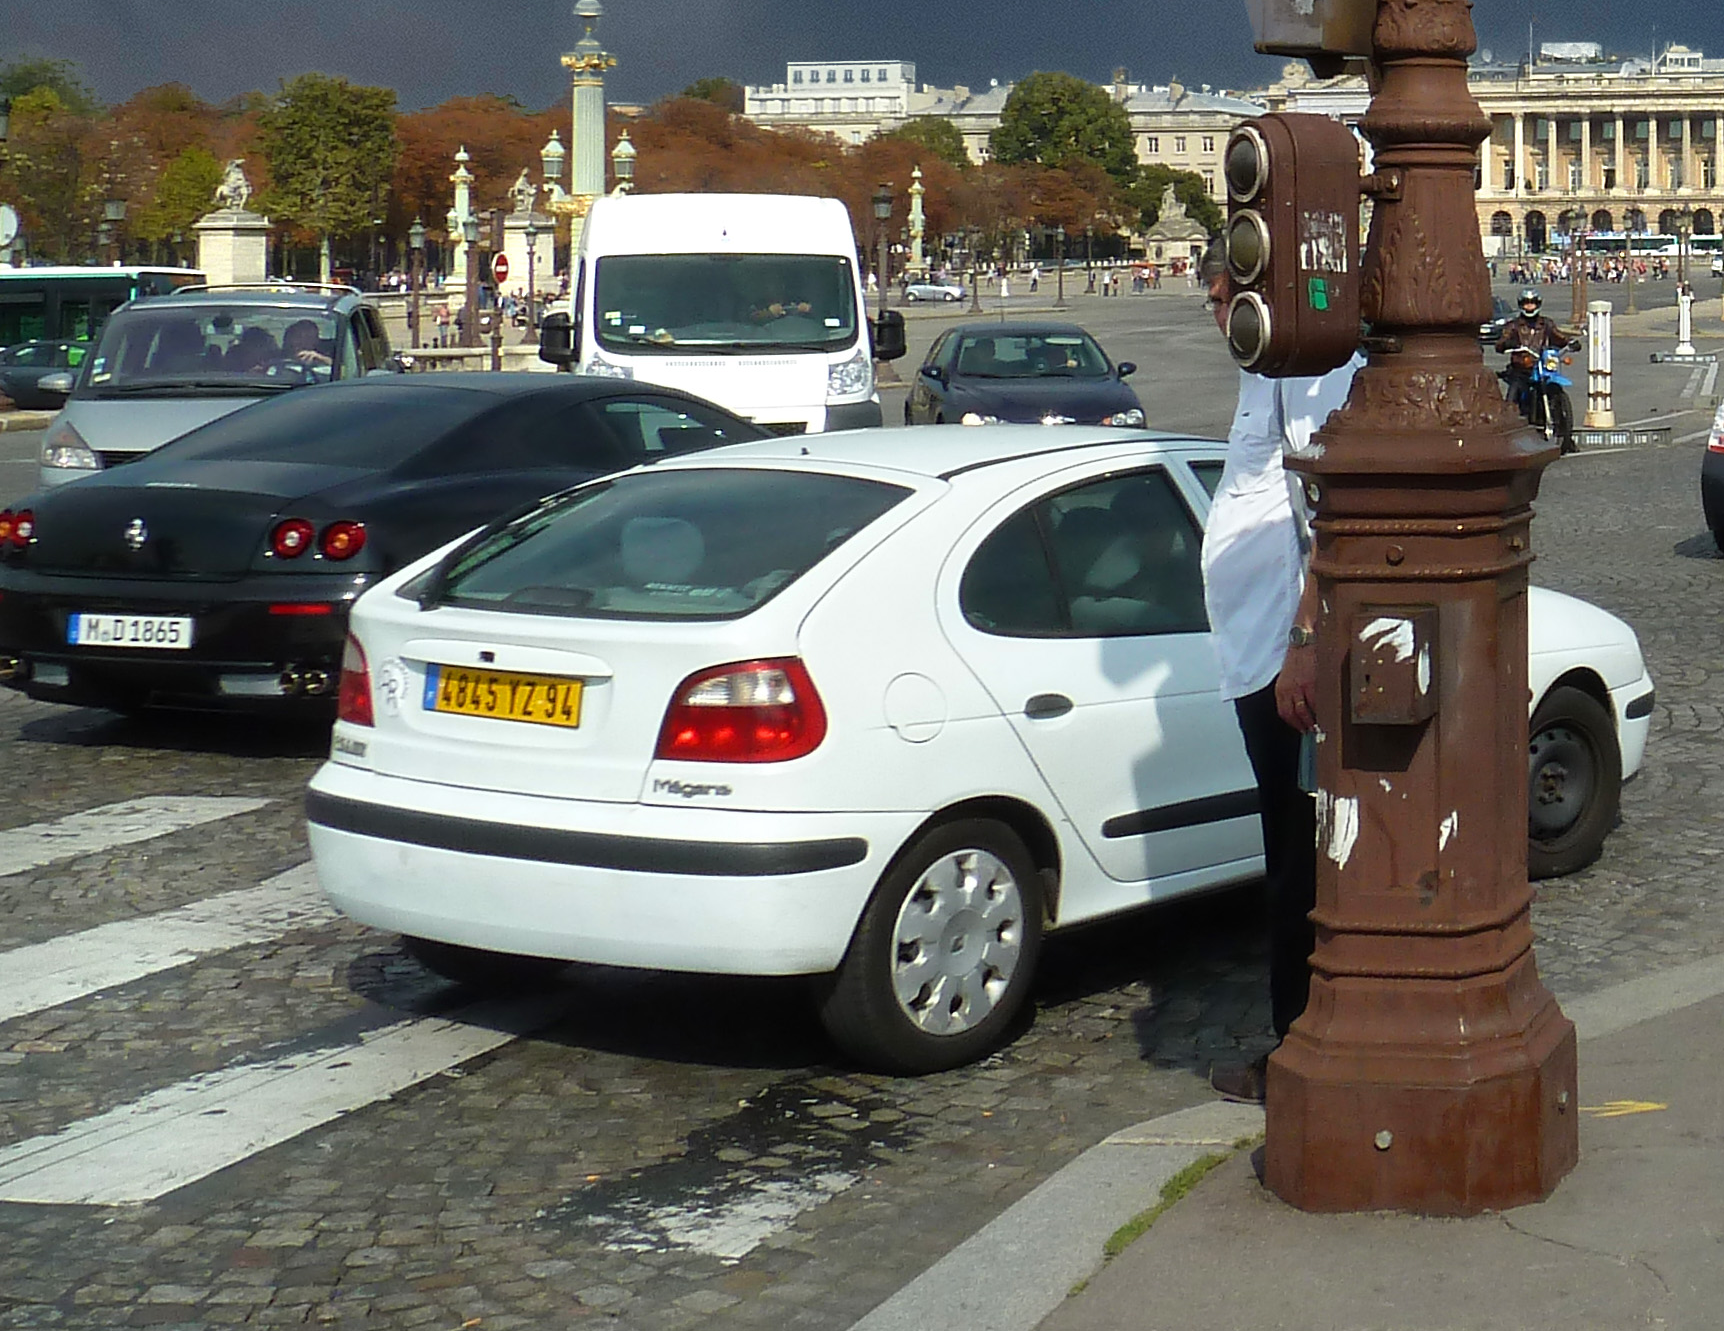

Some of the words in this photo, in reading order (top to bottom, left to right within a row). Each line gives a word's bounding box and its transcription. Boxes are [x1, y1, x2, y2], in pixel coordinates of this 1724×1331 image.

[442, 671, 498, 712] 4845
[509, 679, 538, 716] YZ
[545, 684, 573, 721] 94
